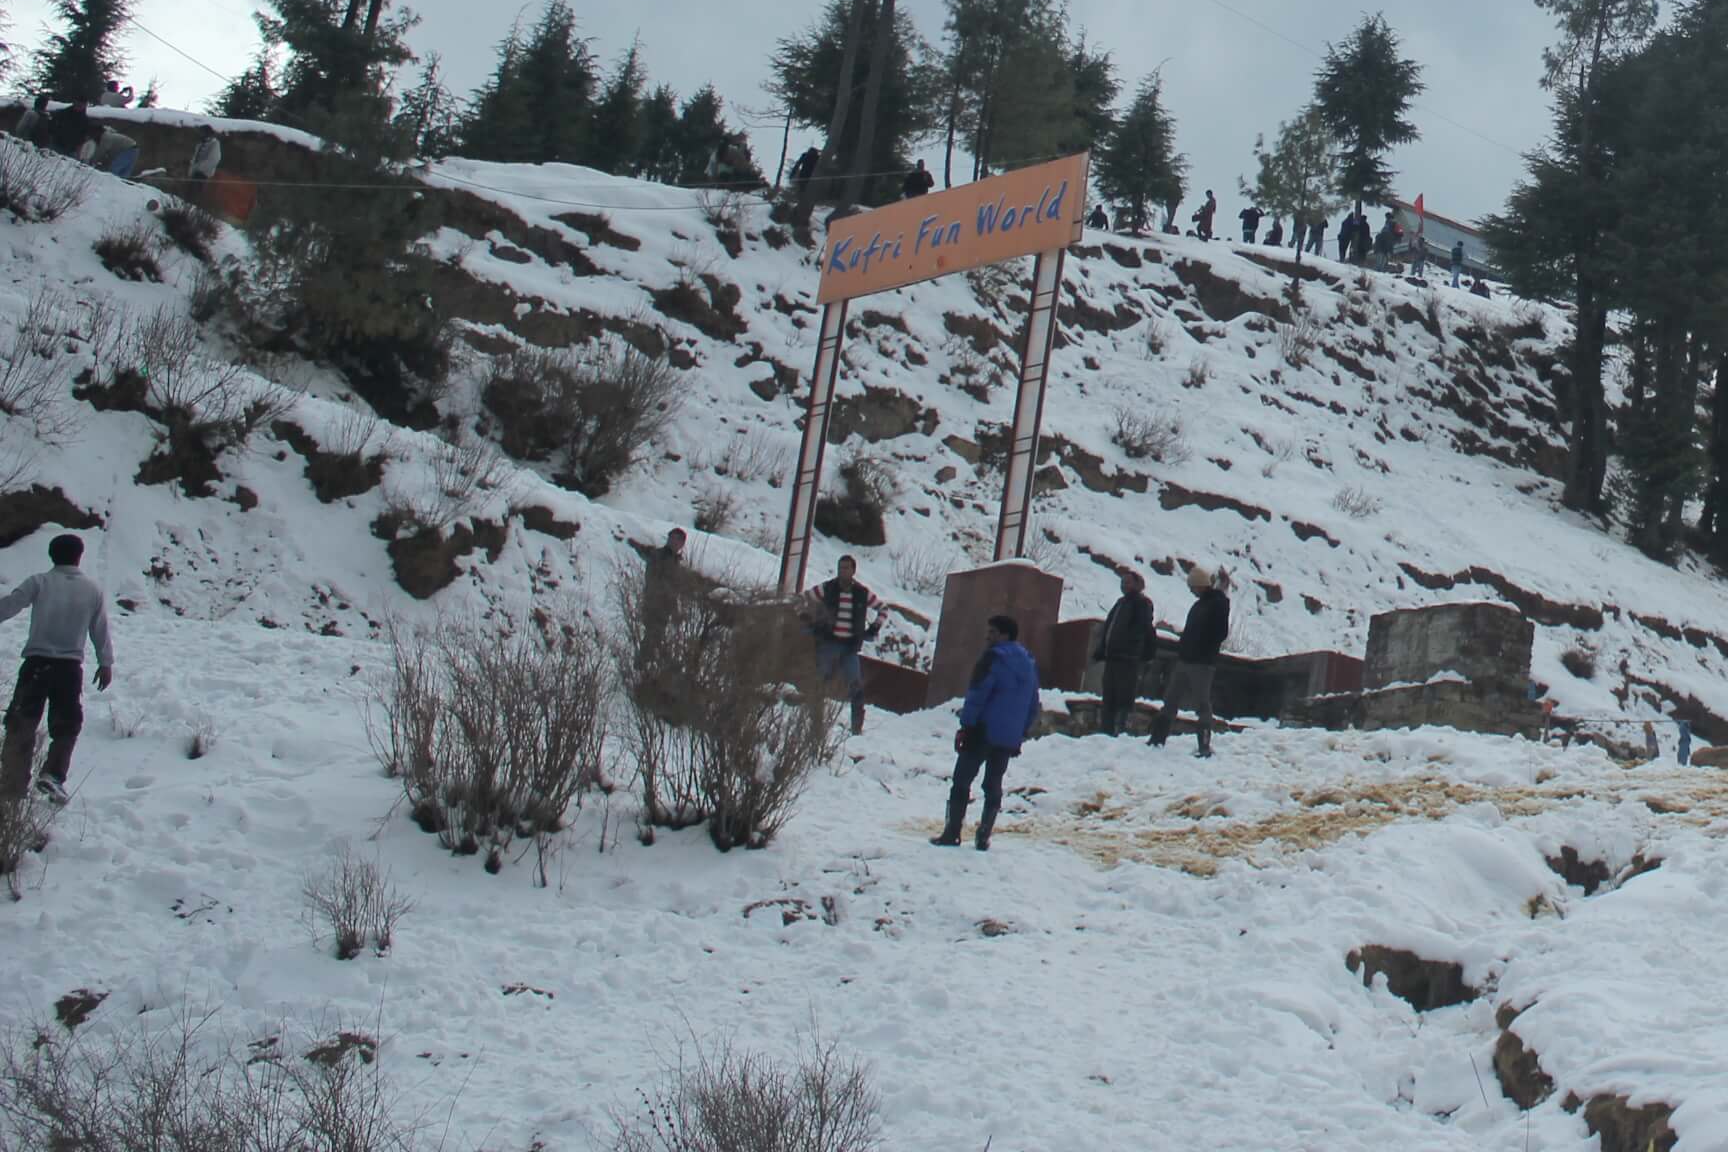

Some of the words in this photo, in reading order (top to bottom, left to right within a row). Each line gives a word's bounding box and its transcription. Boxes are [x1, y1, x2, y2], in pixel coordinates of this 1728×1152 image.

[828, 234, 903, 273] Kufri
[914, 214, 961, 255] Fun
[976, 181, 1068, 236] World
